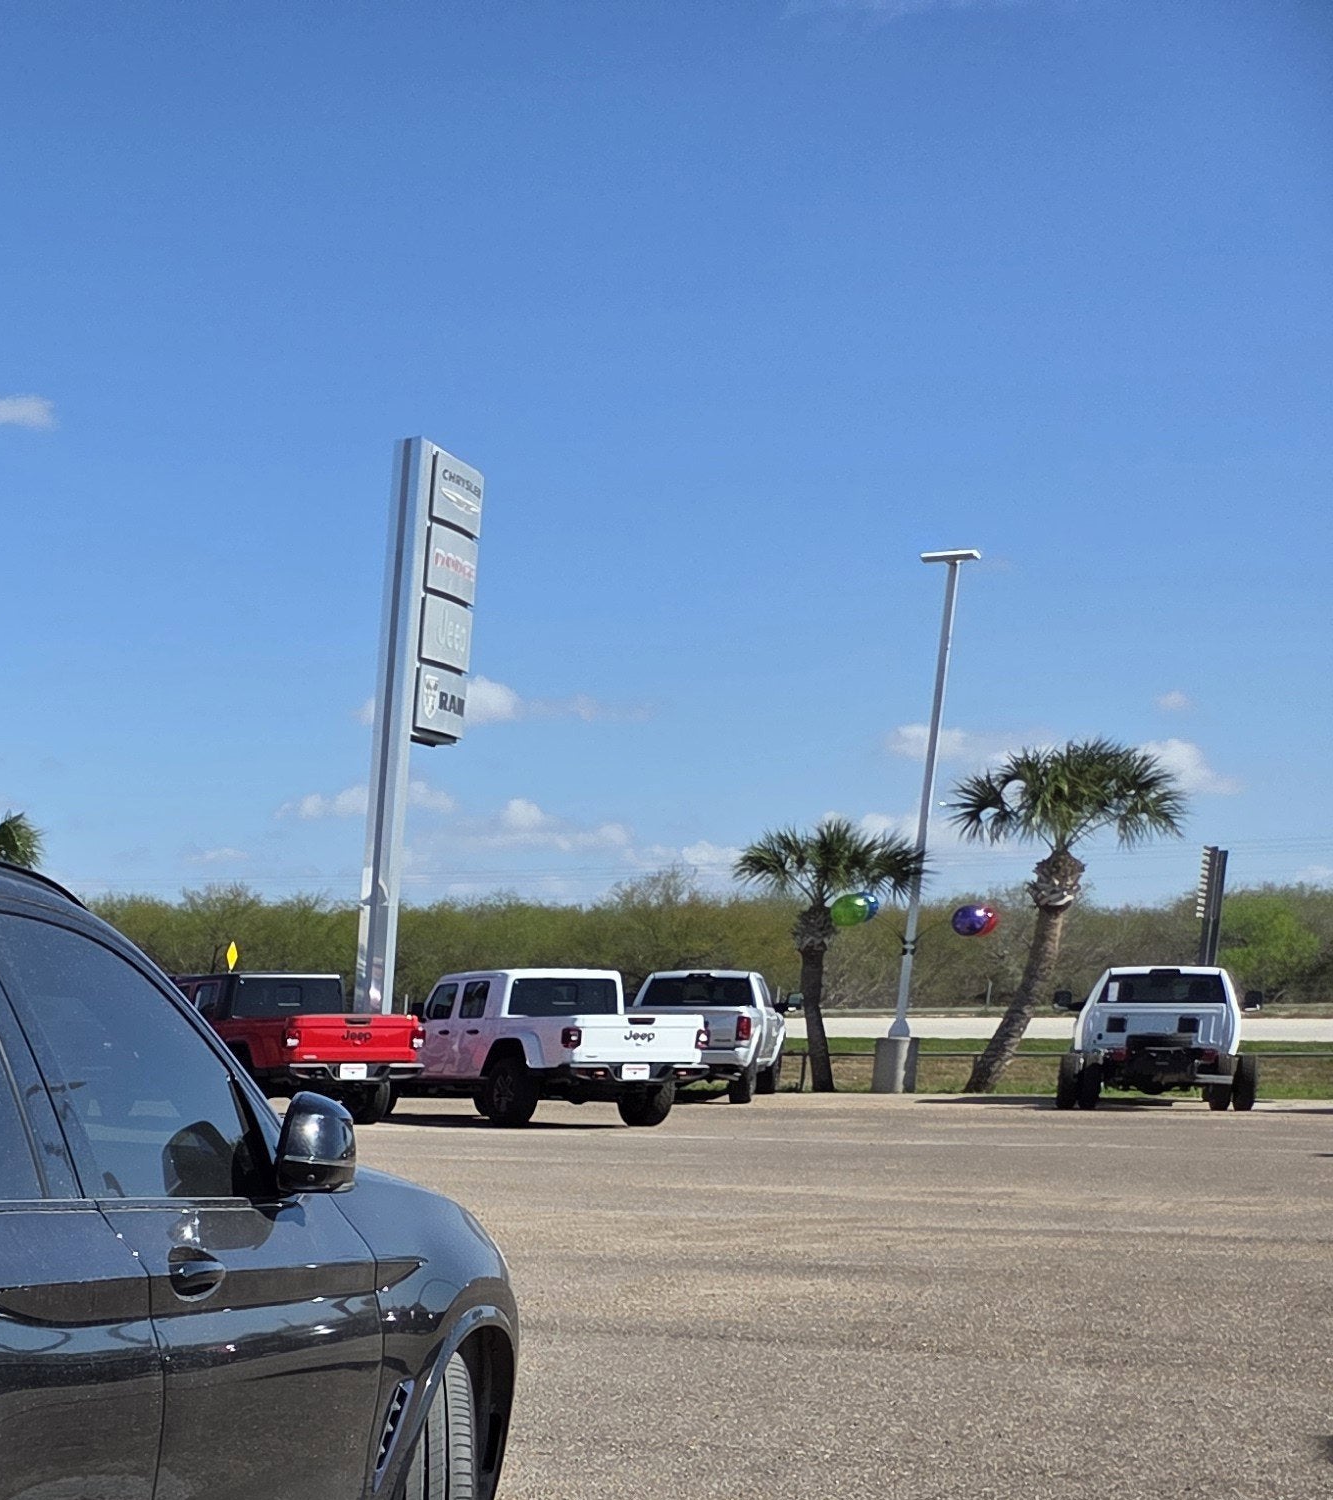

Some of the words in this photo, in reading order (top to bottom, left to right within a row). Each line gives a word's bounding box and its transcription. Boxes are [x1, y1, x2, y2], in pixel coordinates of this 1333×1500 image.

[438, 691, 465, 718] RAM
[340, 1029, 373, 1043] Jeep
[623, 1030, 656, 1043] Jeep
